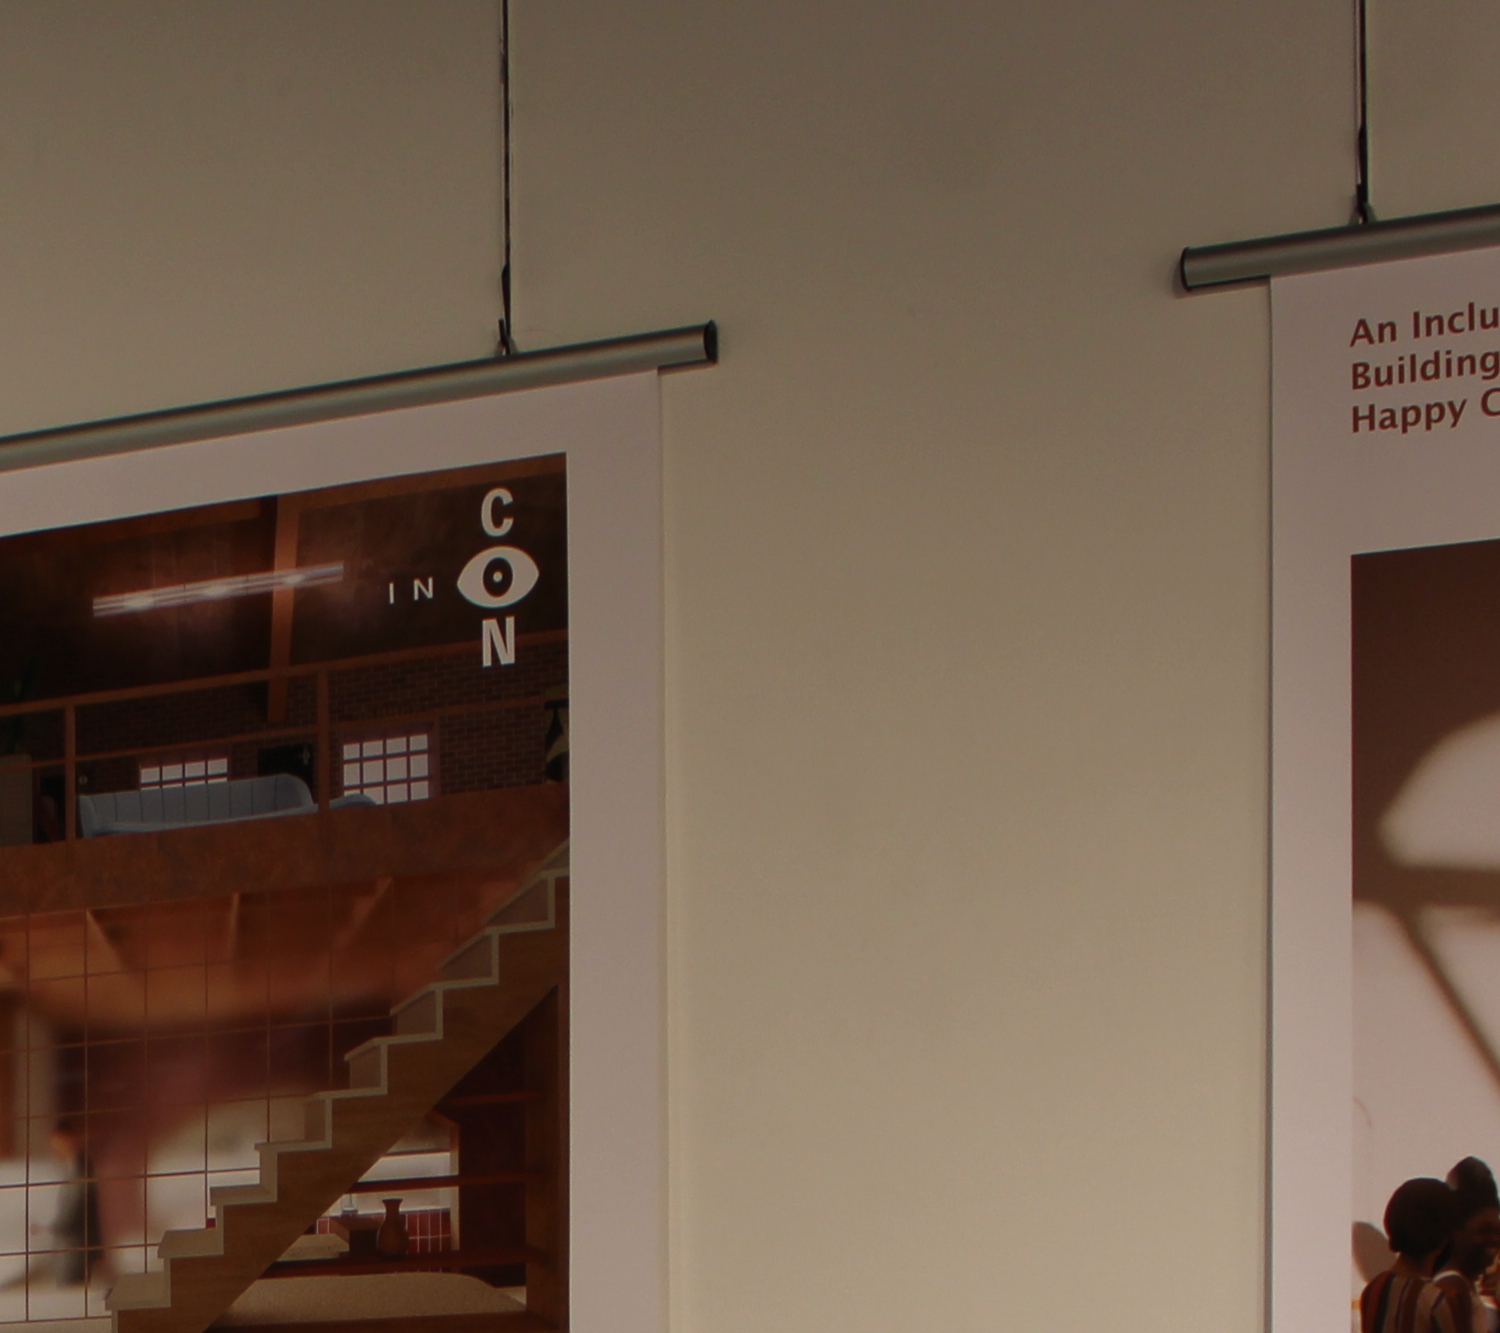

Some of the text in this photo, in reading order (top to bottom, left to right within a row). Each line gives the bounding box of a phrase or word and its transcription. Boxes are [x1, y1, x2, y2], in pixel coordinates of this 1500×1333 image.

[1350, 318, 1397, 347] An
[1352, 350, 1500, 390] Building
[1352, 399, 1467, 434] Happy
